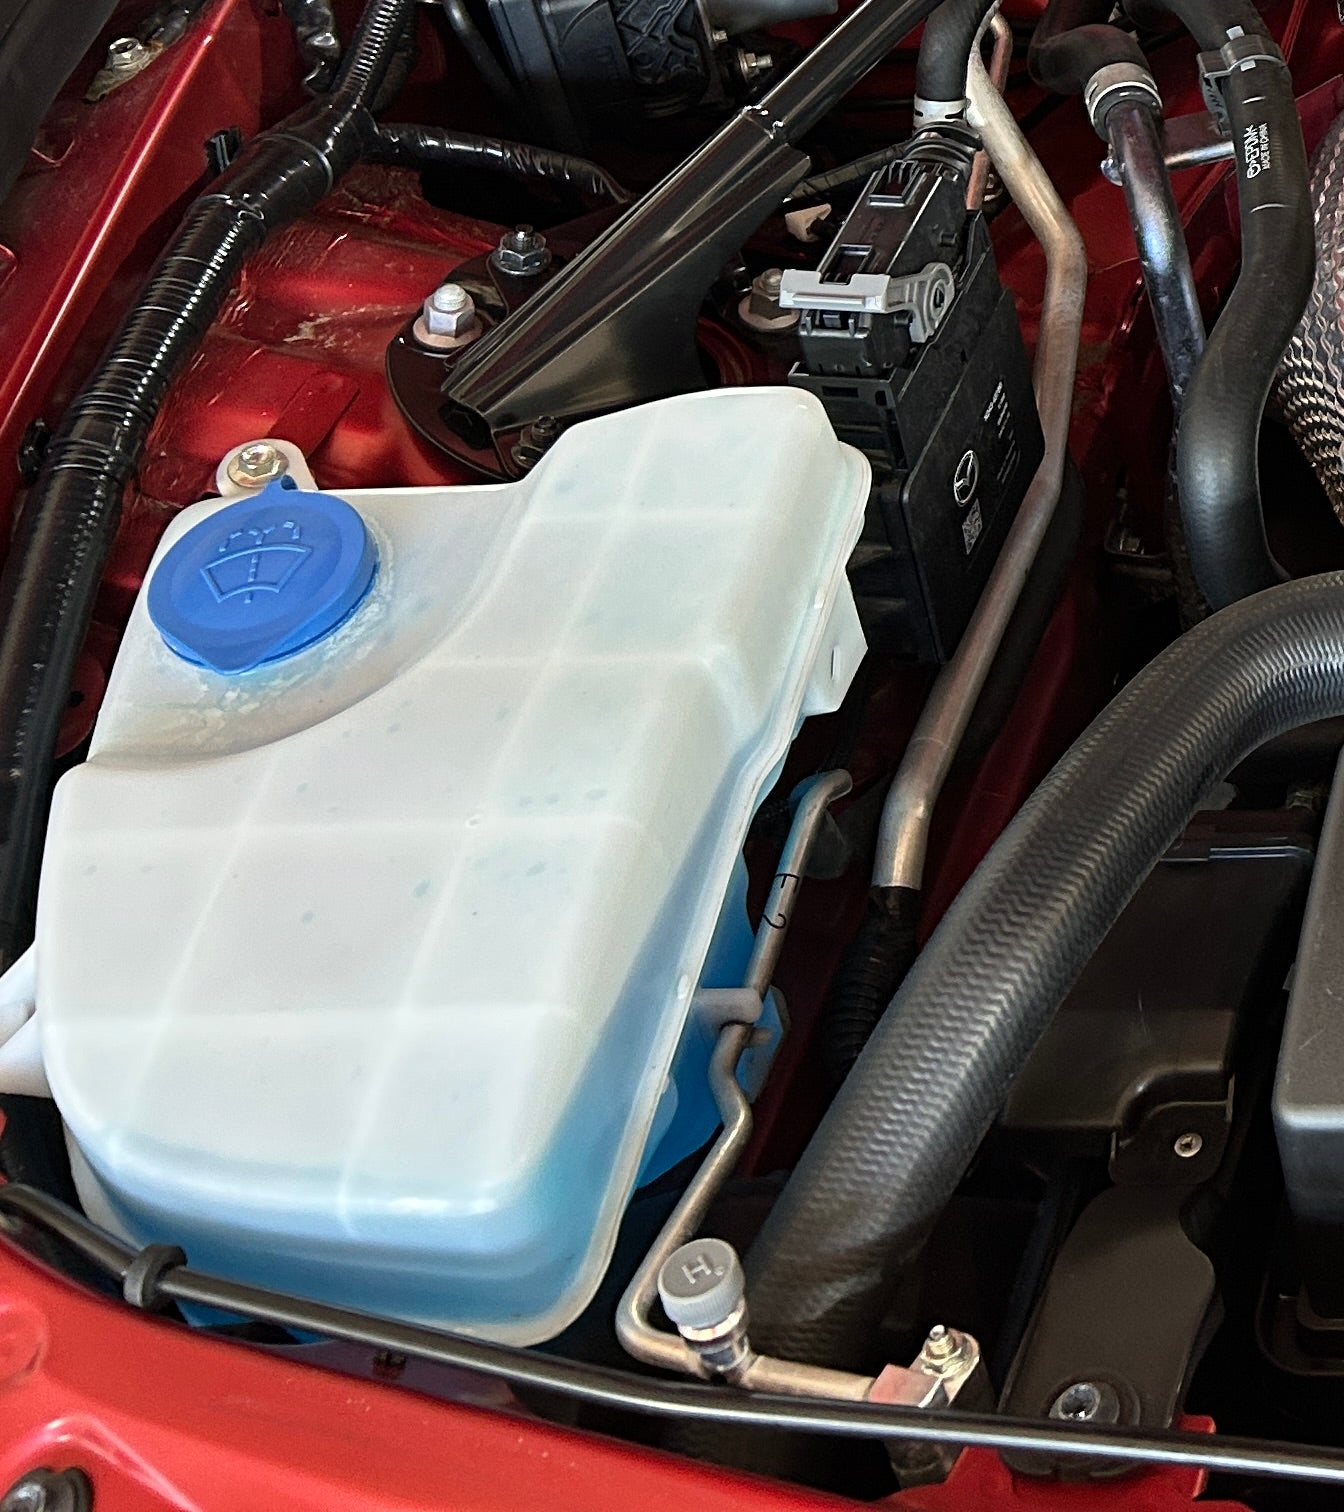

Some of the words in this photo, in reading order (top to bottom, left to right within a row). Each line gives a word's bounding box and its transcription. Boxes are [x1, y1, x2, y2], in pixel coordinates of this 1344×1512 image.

[1258, 123, 1269, 143] CHINA
[1260, 142, 1269, 151] IN
[1260, 150, 1271, 170] MADE
[682, 1255, 712, 1285] H
